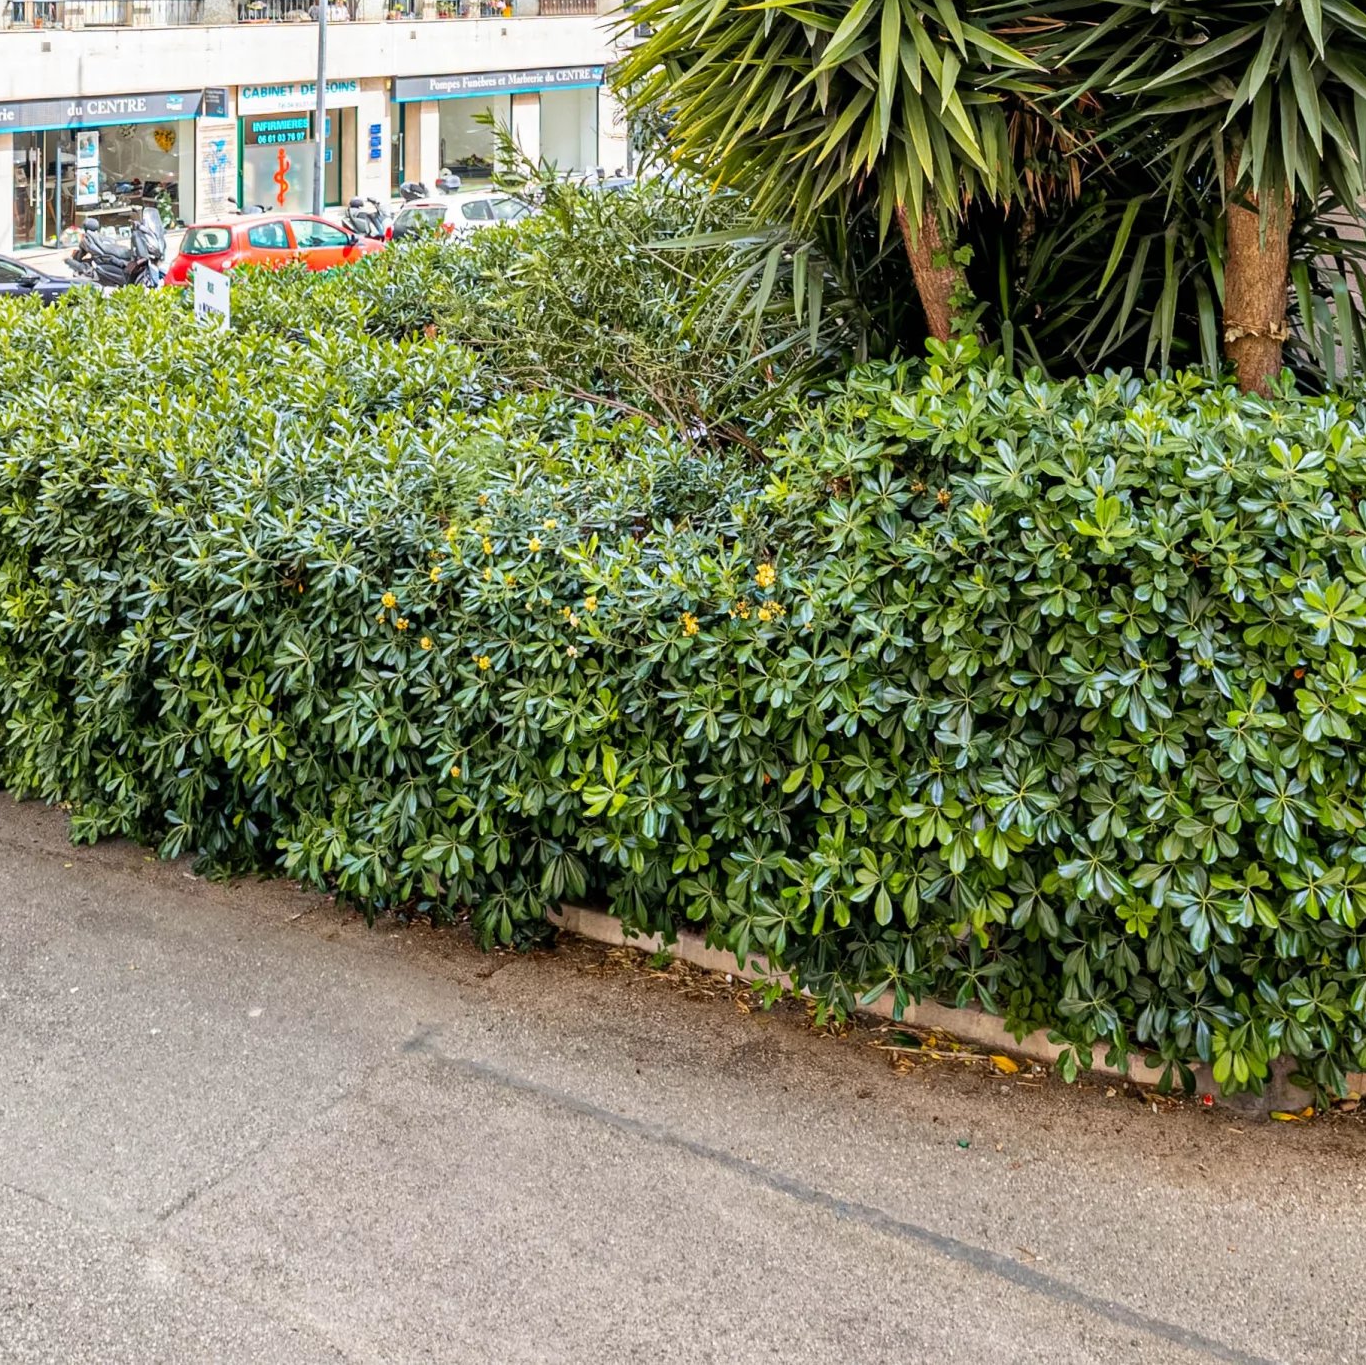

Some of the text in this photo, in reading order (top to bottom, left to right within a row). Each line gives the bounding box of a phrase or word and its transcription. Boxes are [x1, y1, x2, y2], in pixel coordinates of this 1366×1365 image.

[556, 68, 590, 81] CENTRE
[243, 84, 294, 98] CABINET
[301, 83, 316, 95] DE
[67, 103, 82, 116] du
[87, 98, 146, 114] CENTRE
[253, 118, 309, 132] INFIRMIERES
